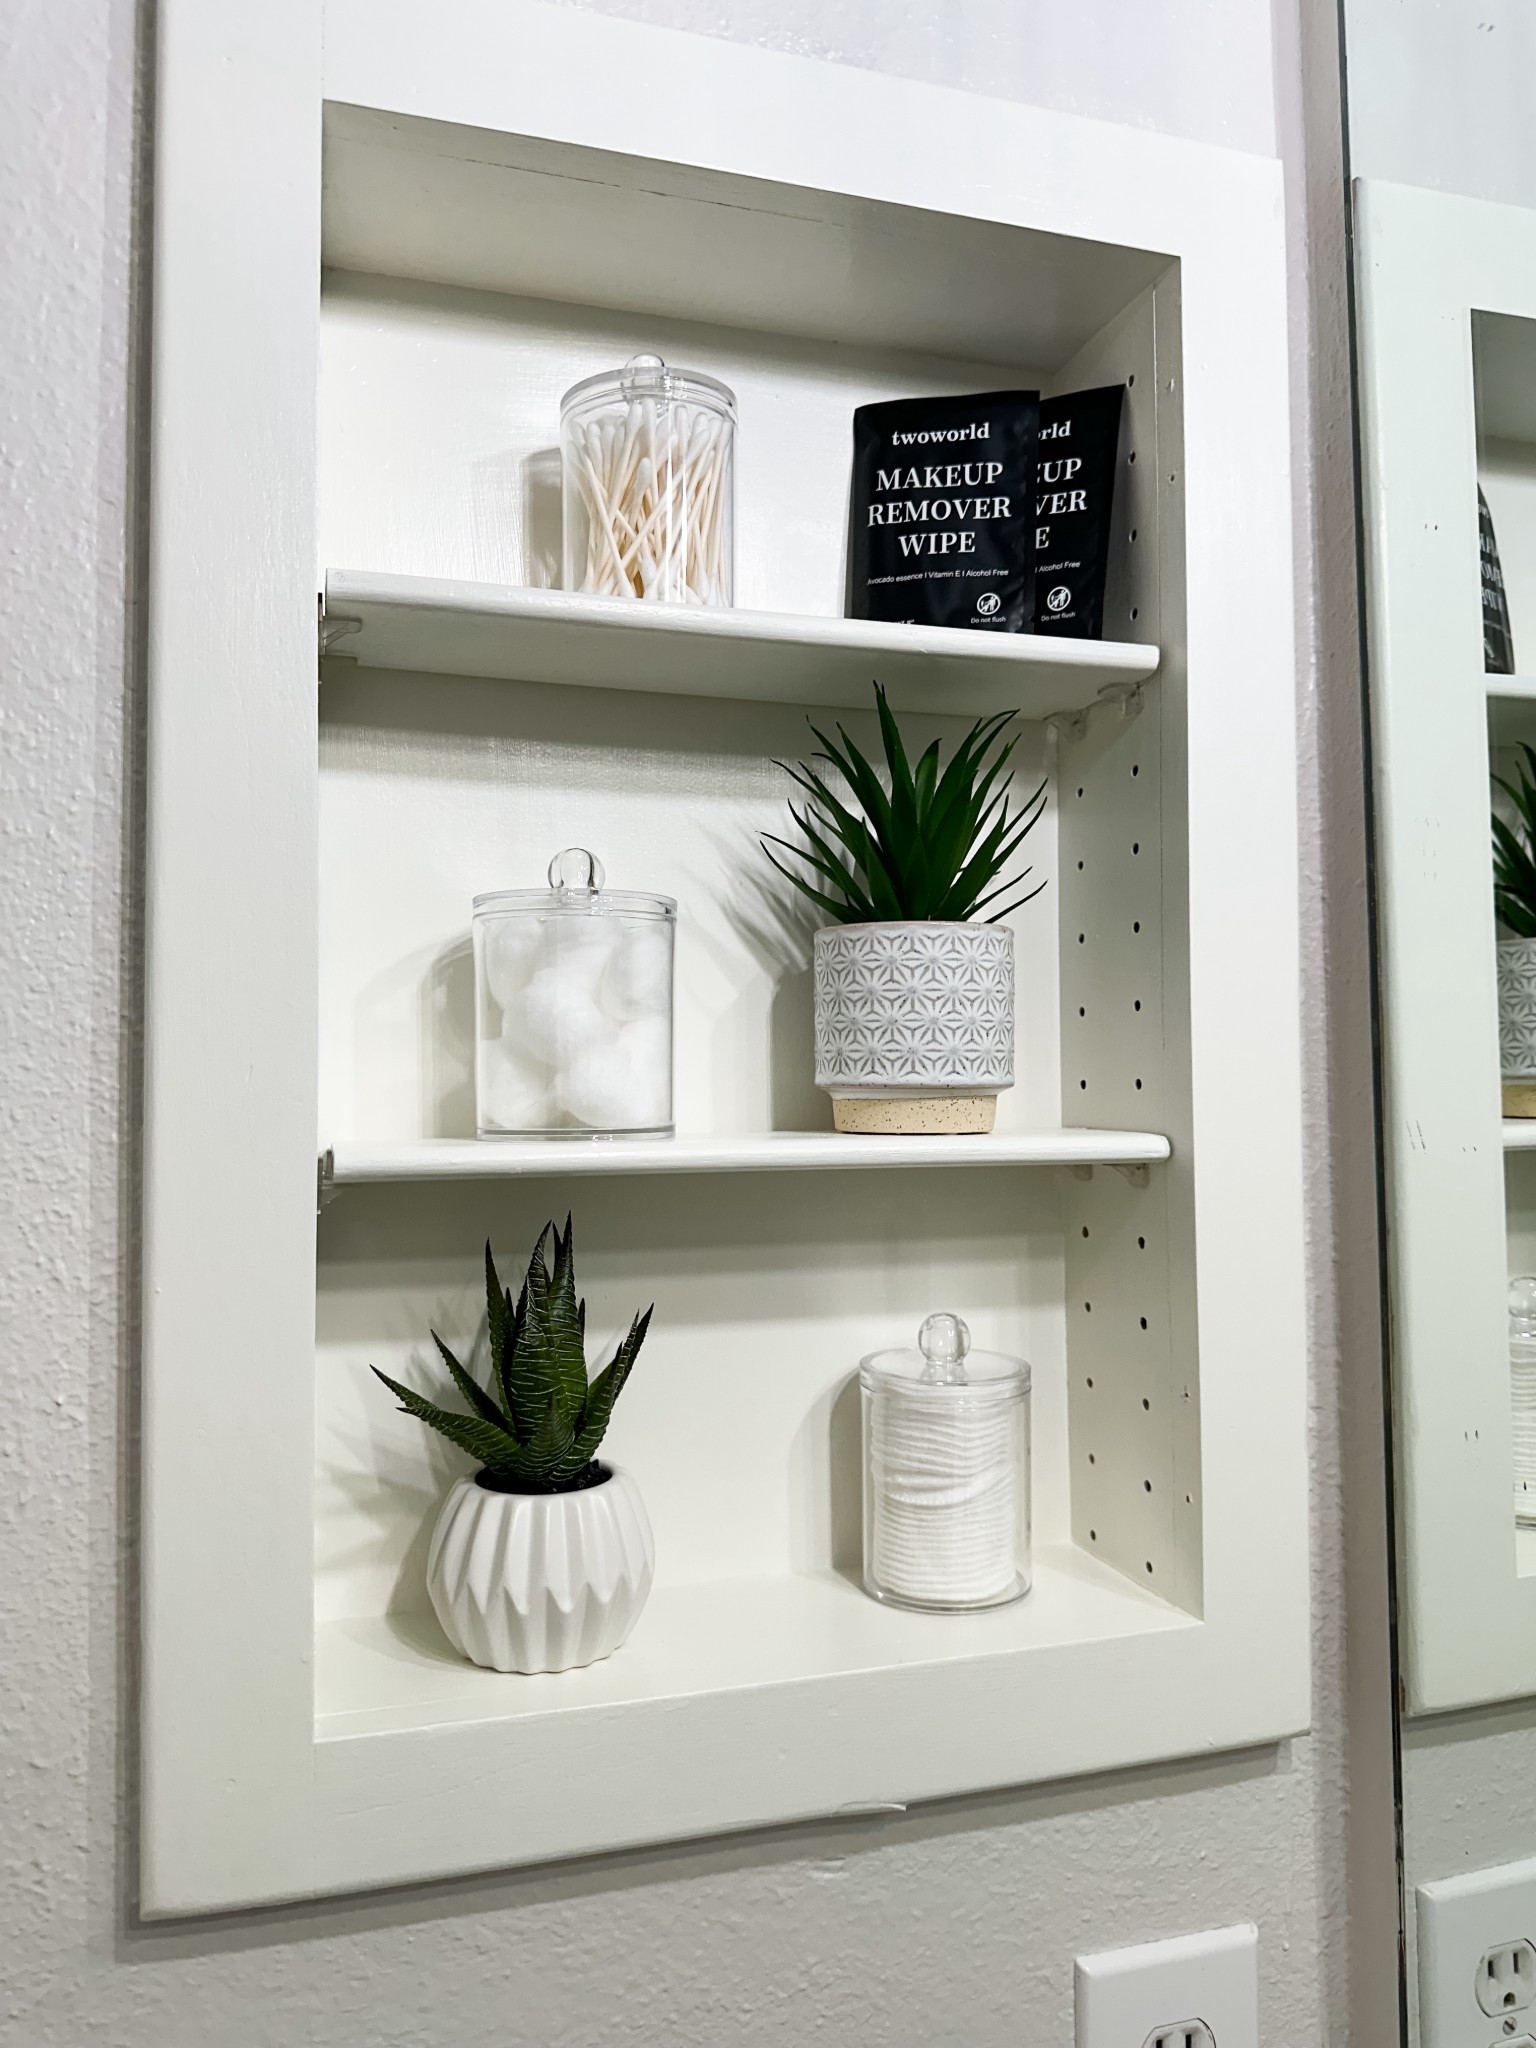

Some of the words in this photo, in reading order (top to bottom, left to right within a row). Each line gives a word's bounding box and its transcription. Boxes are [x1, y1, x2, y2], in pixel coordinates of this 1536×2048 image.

[891, 422, 990, 446] twoworld
[875, 461, 1004, 492] MAKEUP
[866, 496, 1012, 528] REMOVER
[898, 531, 977, 557] WIPE
[867, 576, 895, 586] Avocado
[895, 572, 923, 583] essence
[928, 570, 954, 579] Vitamin
[955, 569, 961, 578] E
[966, 568, 991, 577] Alcohol
[992, 568, 1009, 577] Free
[1038, 562, 1064, 573] Alcohol
[1064, 560, 1081, 569] Free
[1040, 614, 1050, 622] Do
[1050, 613, 1061, 621] not
[1061, 611, 1076, 619] flush
